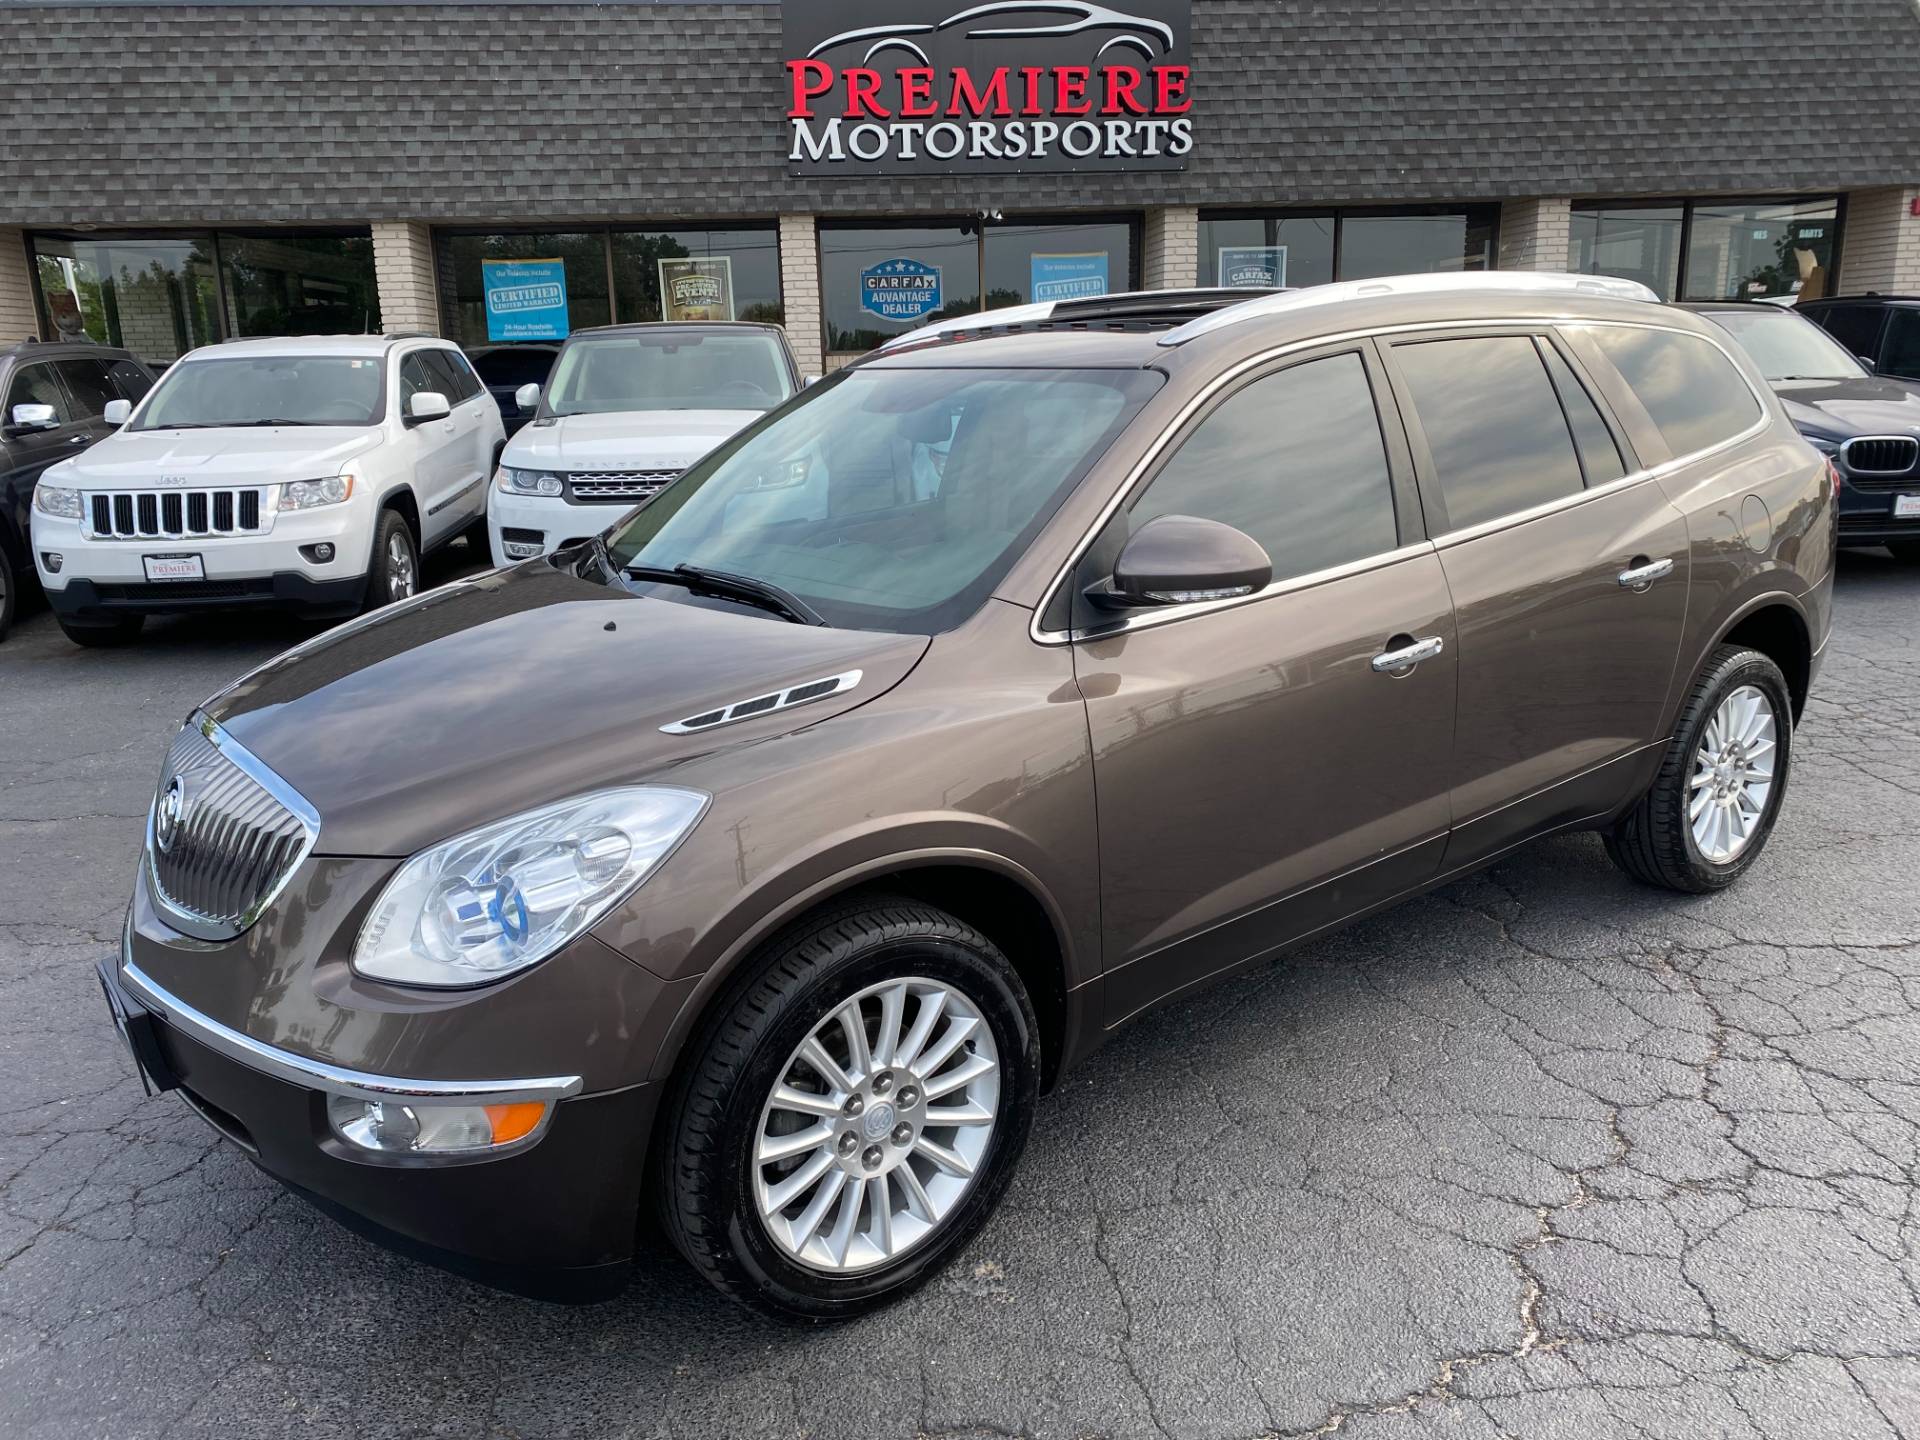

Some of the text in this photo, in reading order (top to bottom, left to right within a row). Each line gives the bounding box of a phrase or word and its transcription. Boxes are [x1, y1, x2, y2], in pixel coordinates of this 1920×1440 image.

[786, 59, 1193, 119] PREMIERE
[788, 118, 1193, 161] MOTORSPORTS
[868, 277, 934, 289] CARFAX
[492, 286, 559, 303] CERTIFIED
[872, 291, 932, 303] ADVANTAGE
[882, 303, 922, 314] DEALER
